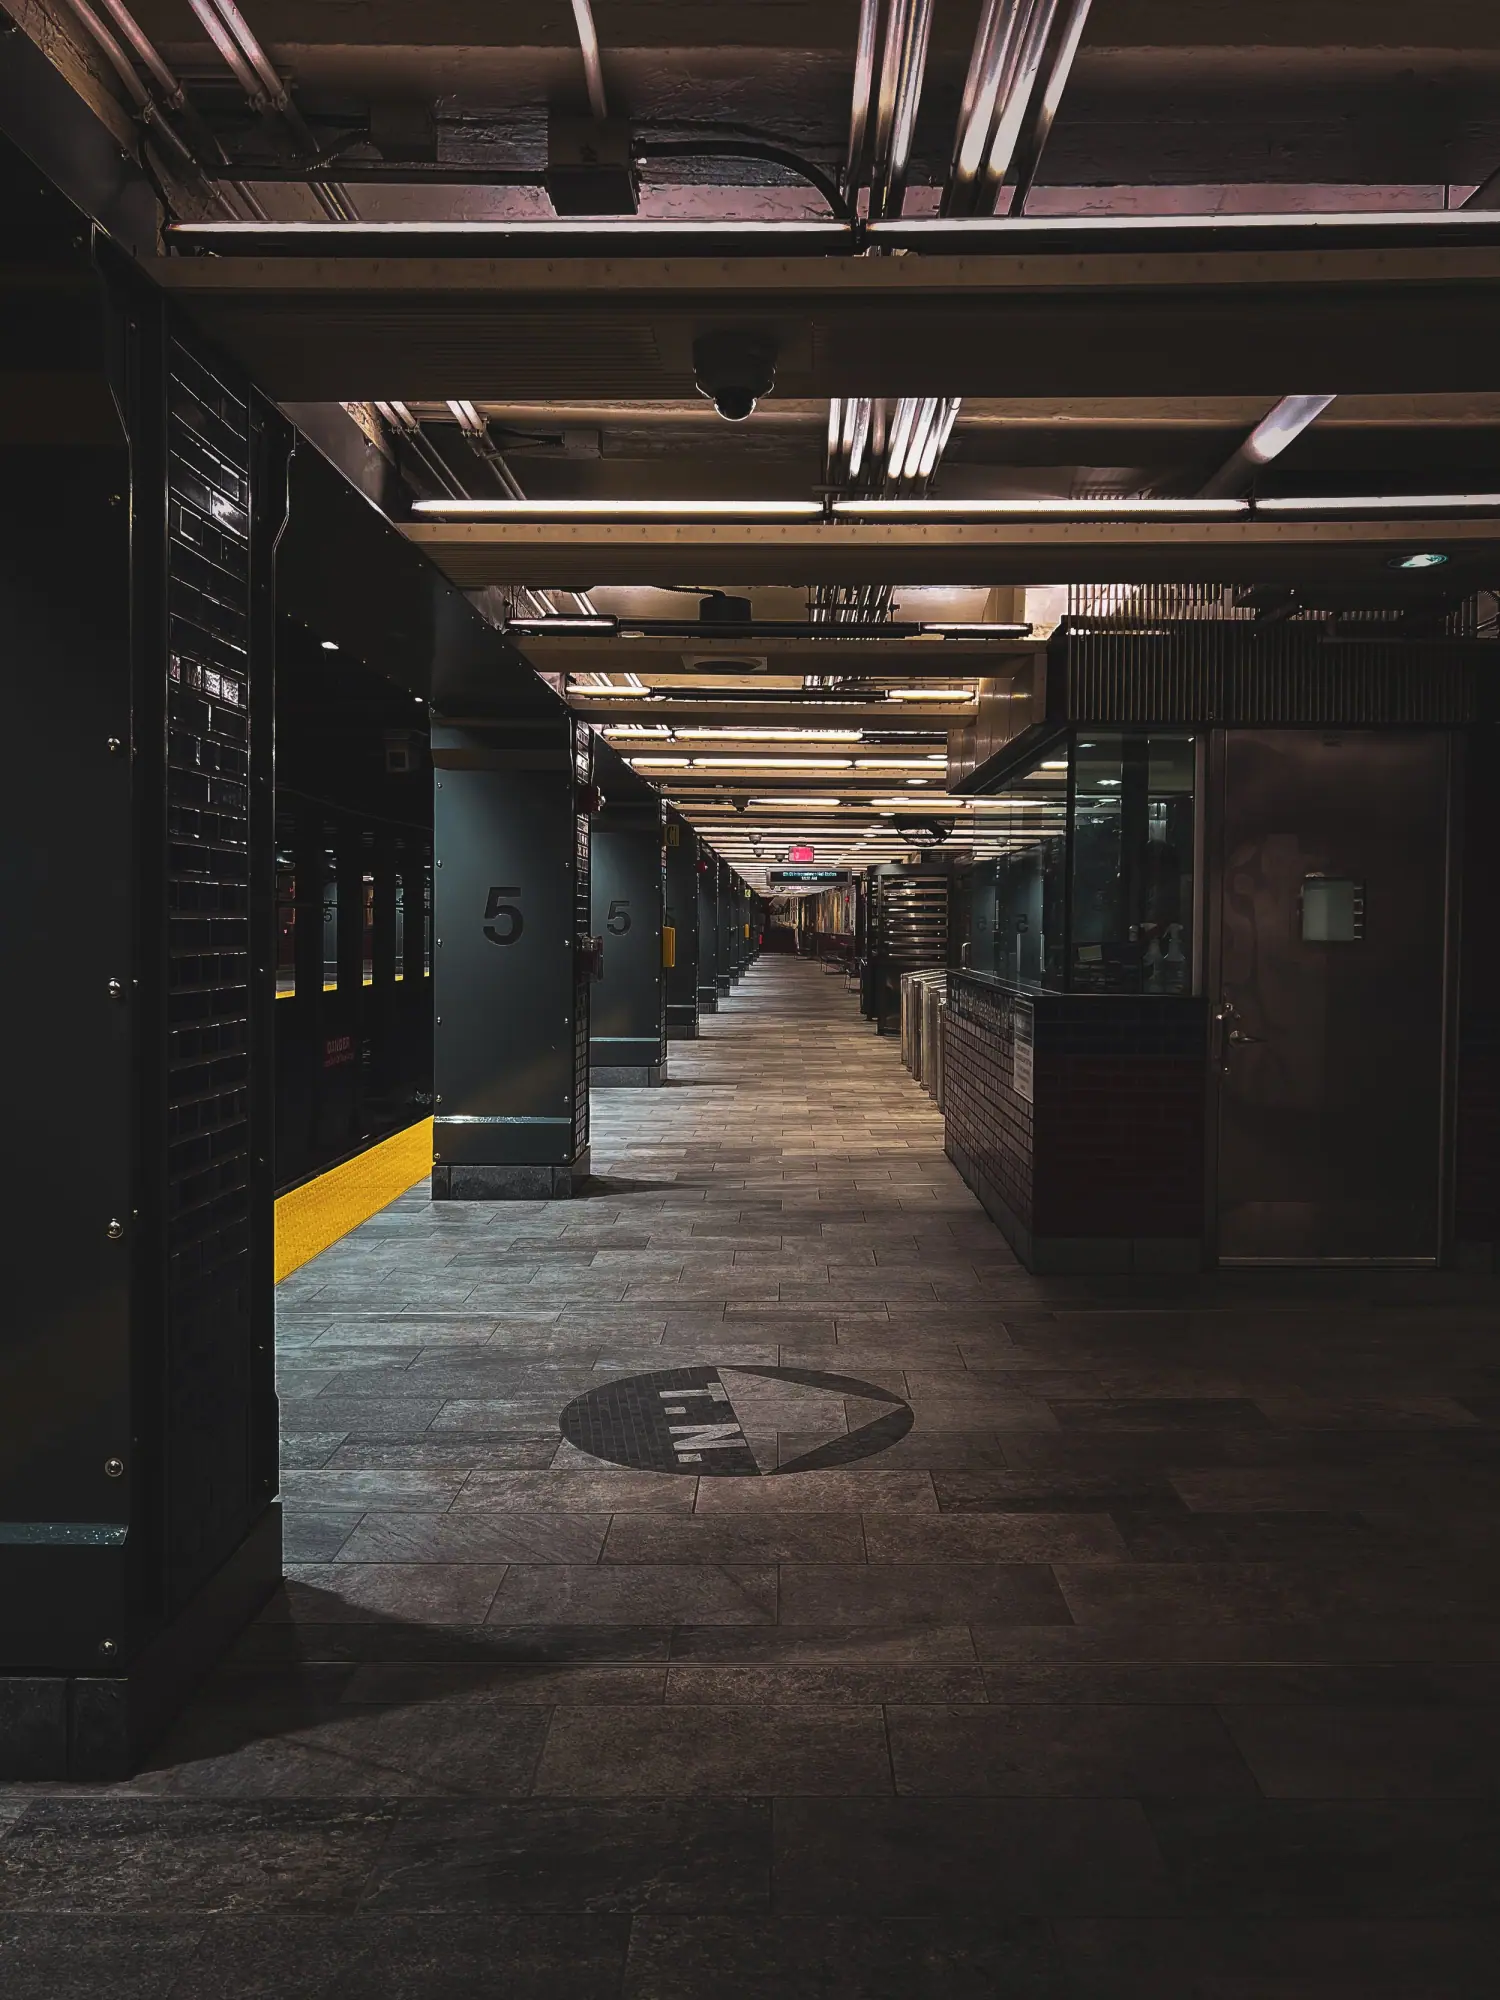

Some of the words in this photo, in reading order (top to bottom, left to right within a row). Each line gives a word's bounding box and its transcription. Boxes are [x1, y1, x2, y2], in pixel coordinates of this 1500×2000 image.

[482, 886, 524, 946] 5
[606, 900, 632, 936] 5
[327, 1036, 350, 1055] DANGER
